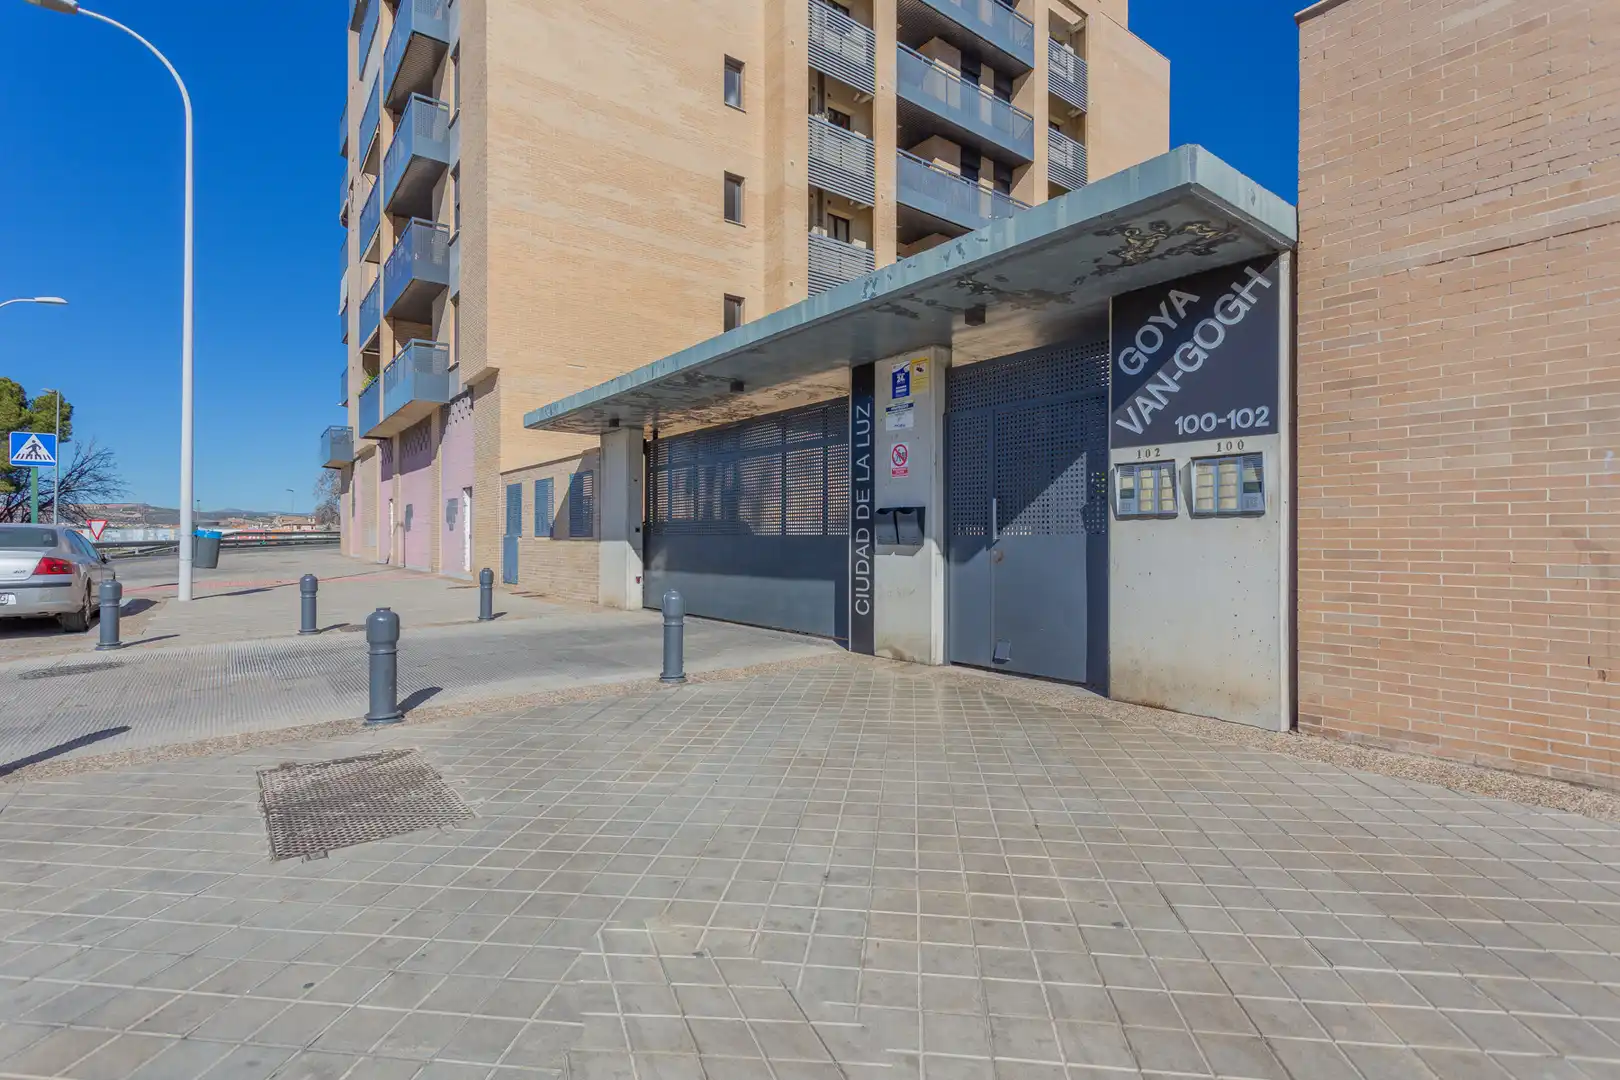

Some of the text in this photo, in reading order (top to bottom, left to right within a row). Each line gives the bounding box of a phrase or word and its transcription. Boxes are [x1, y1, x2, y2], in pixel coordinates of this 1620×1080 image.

[1116, 266, 1272, 435] VAN-GOGH
[1118, 289, 1200, 375] GOYA
[1175, 405, 1270, 435] 100-102
[1216, 439, 1245, 452] 100
[1136, 447, 1161, 459] 102
[855, 402, 870, 615] CIUDAD DE LA LUZ
